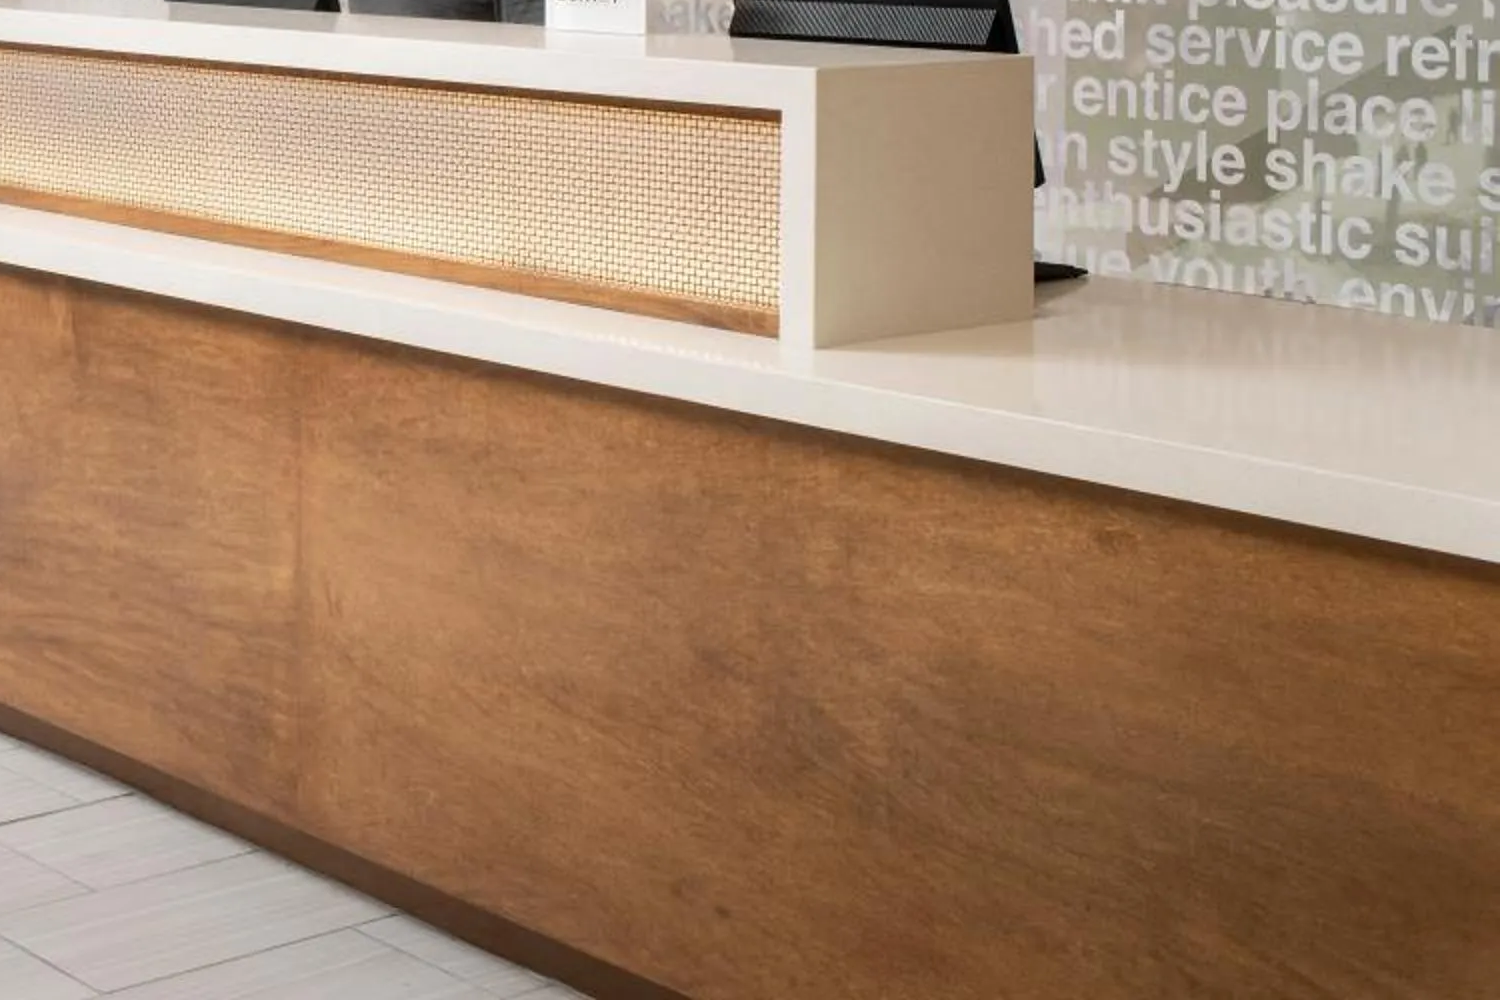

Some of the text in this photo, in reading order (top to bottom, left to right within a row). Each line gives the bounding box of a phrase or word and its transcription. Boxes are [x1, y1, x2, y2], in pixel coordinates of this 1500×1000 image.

[1145, 14, 1365, 76] service
[1072, 70, 1250, 127] entice
[1266, 76, 1439, 145] place
[1106, 128, 1248, 193] style
[1264, 137, 1458, 207] shake
